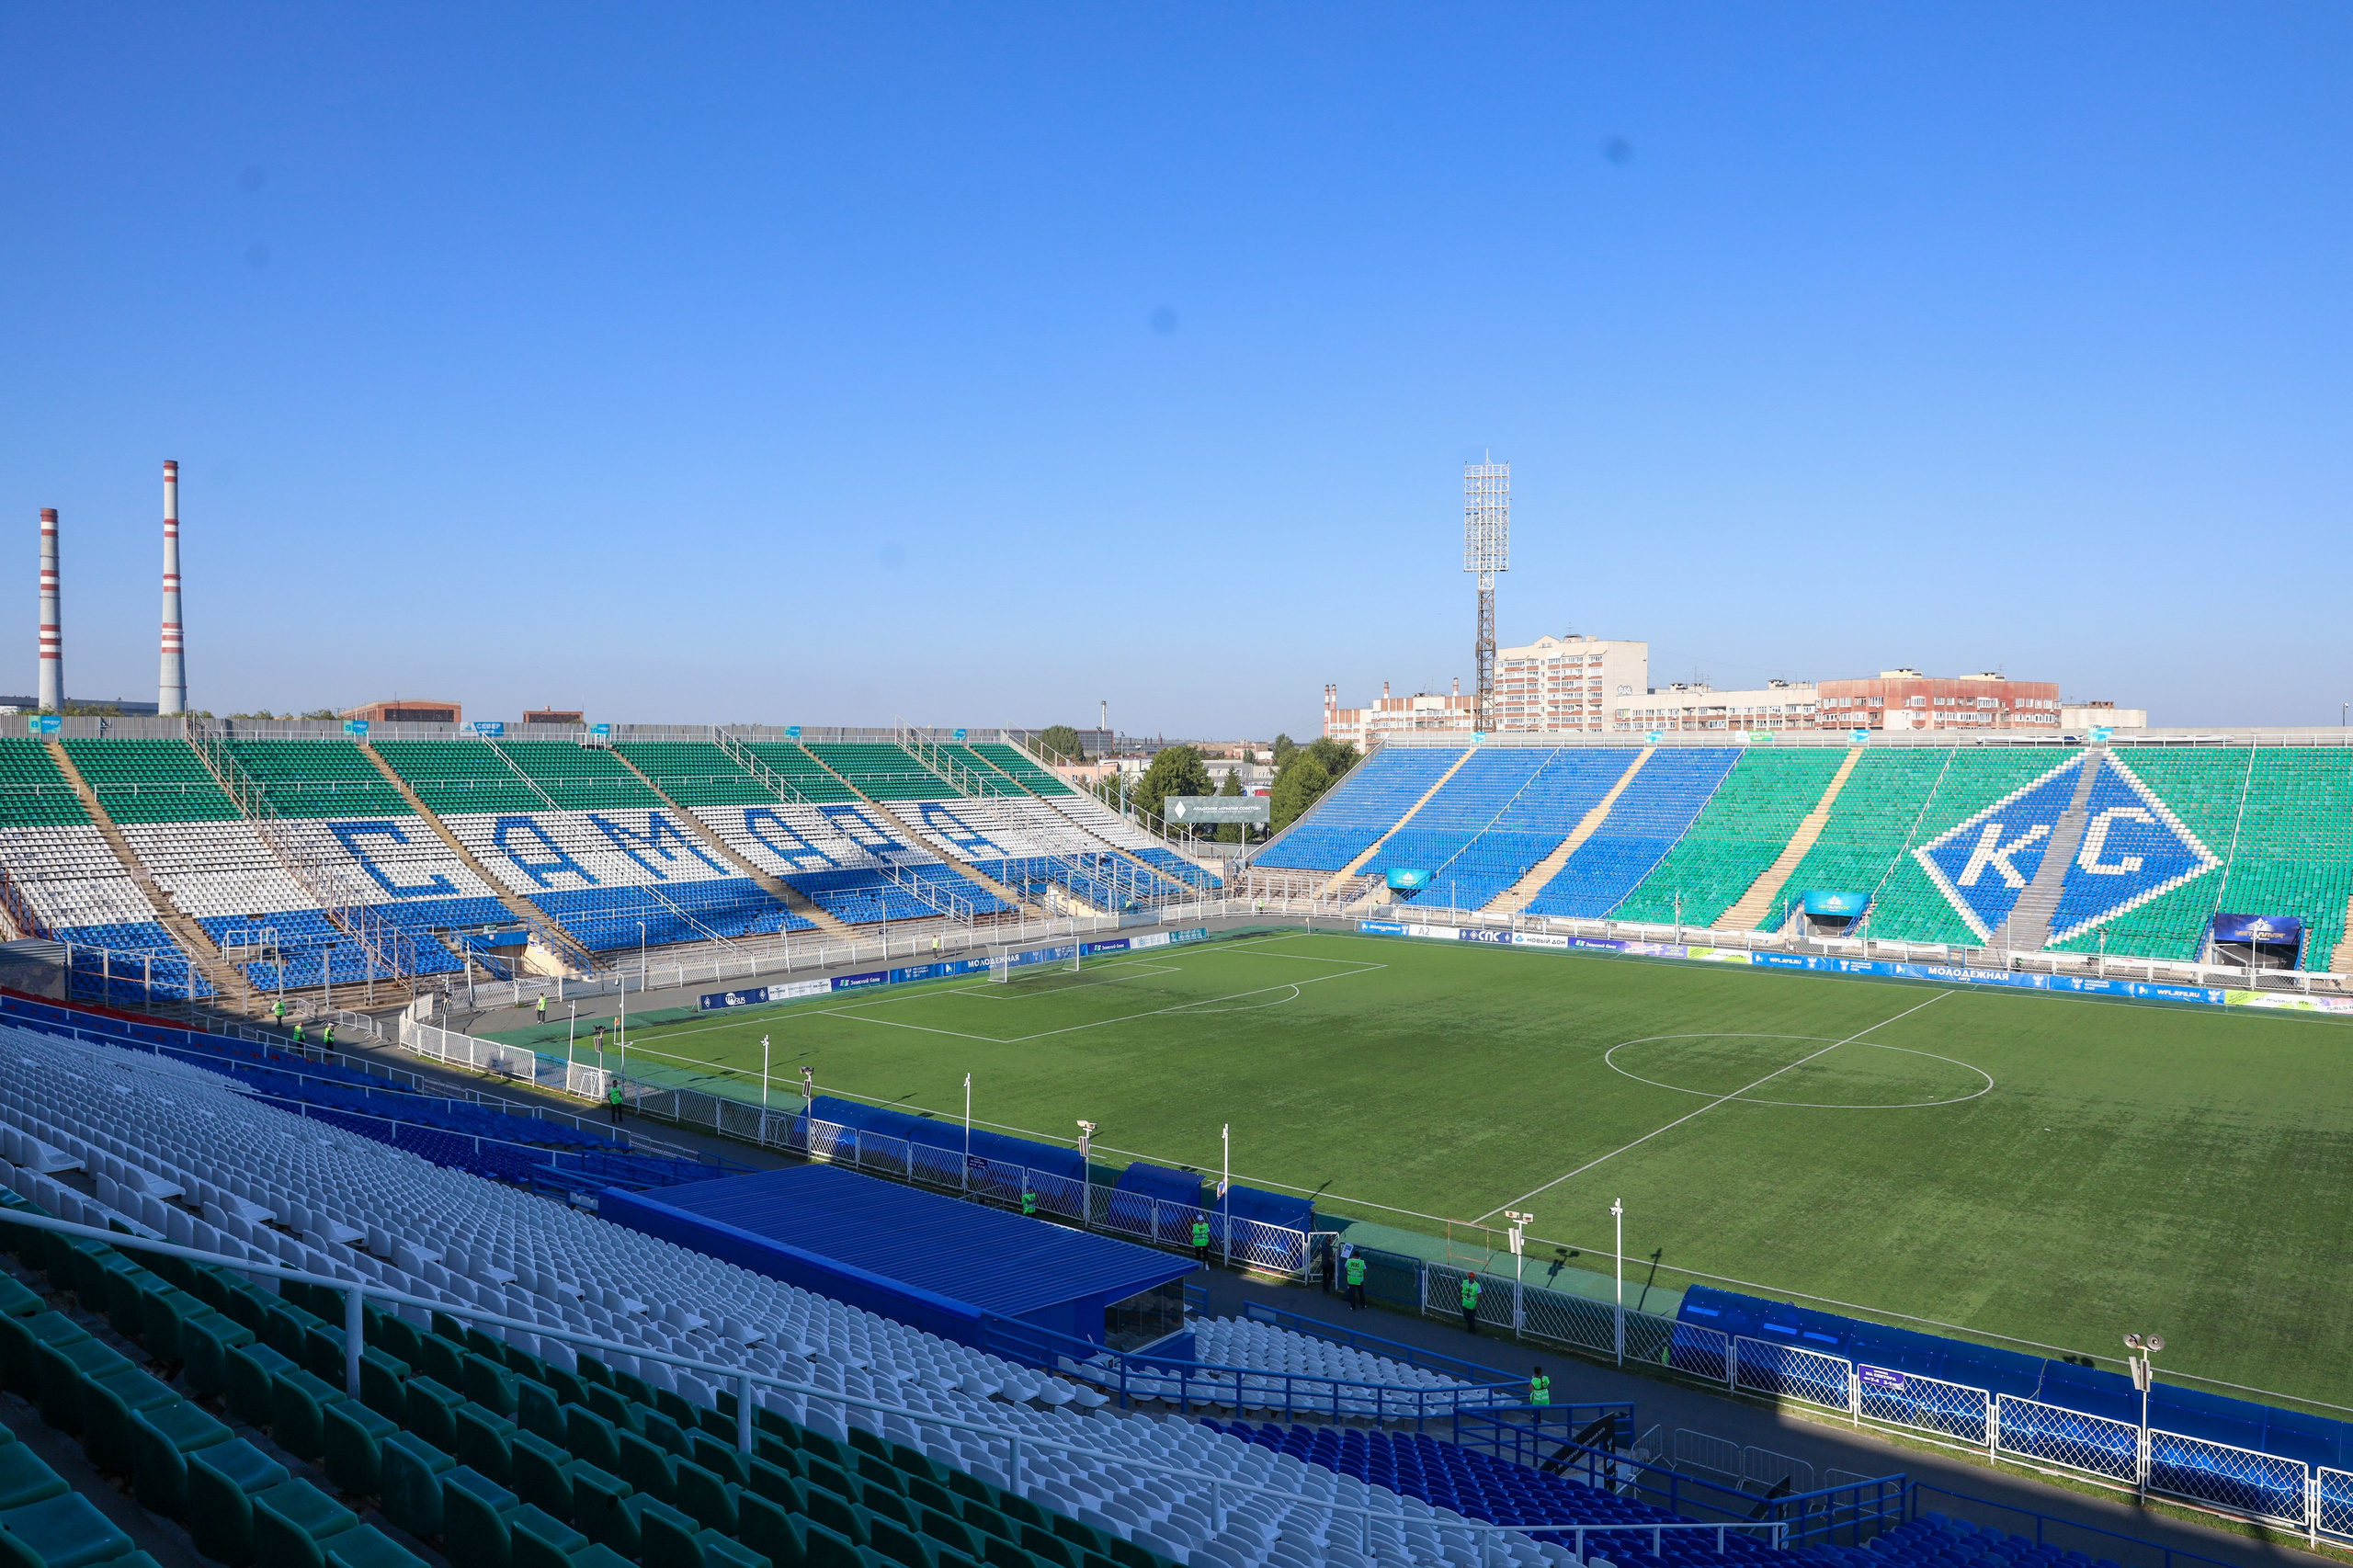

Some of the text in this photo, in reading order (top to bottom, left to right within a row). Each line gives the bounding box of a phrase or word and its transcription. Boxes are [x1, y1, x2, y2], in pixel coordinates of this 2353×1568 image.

[1478, 931, 1502, 942] СПС
[967, 954, 1020, 968] МОЛОДЕЖНАЯ
[1768, 957, 1802, 965] WFL.RFS.RU
[1927, 967, 2009, 981] МОЛОДЕЖНАЯ
[850, 977, 870, 986] Земский
[2157, 988, 2200, 998] WFL.RFS.RU
